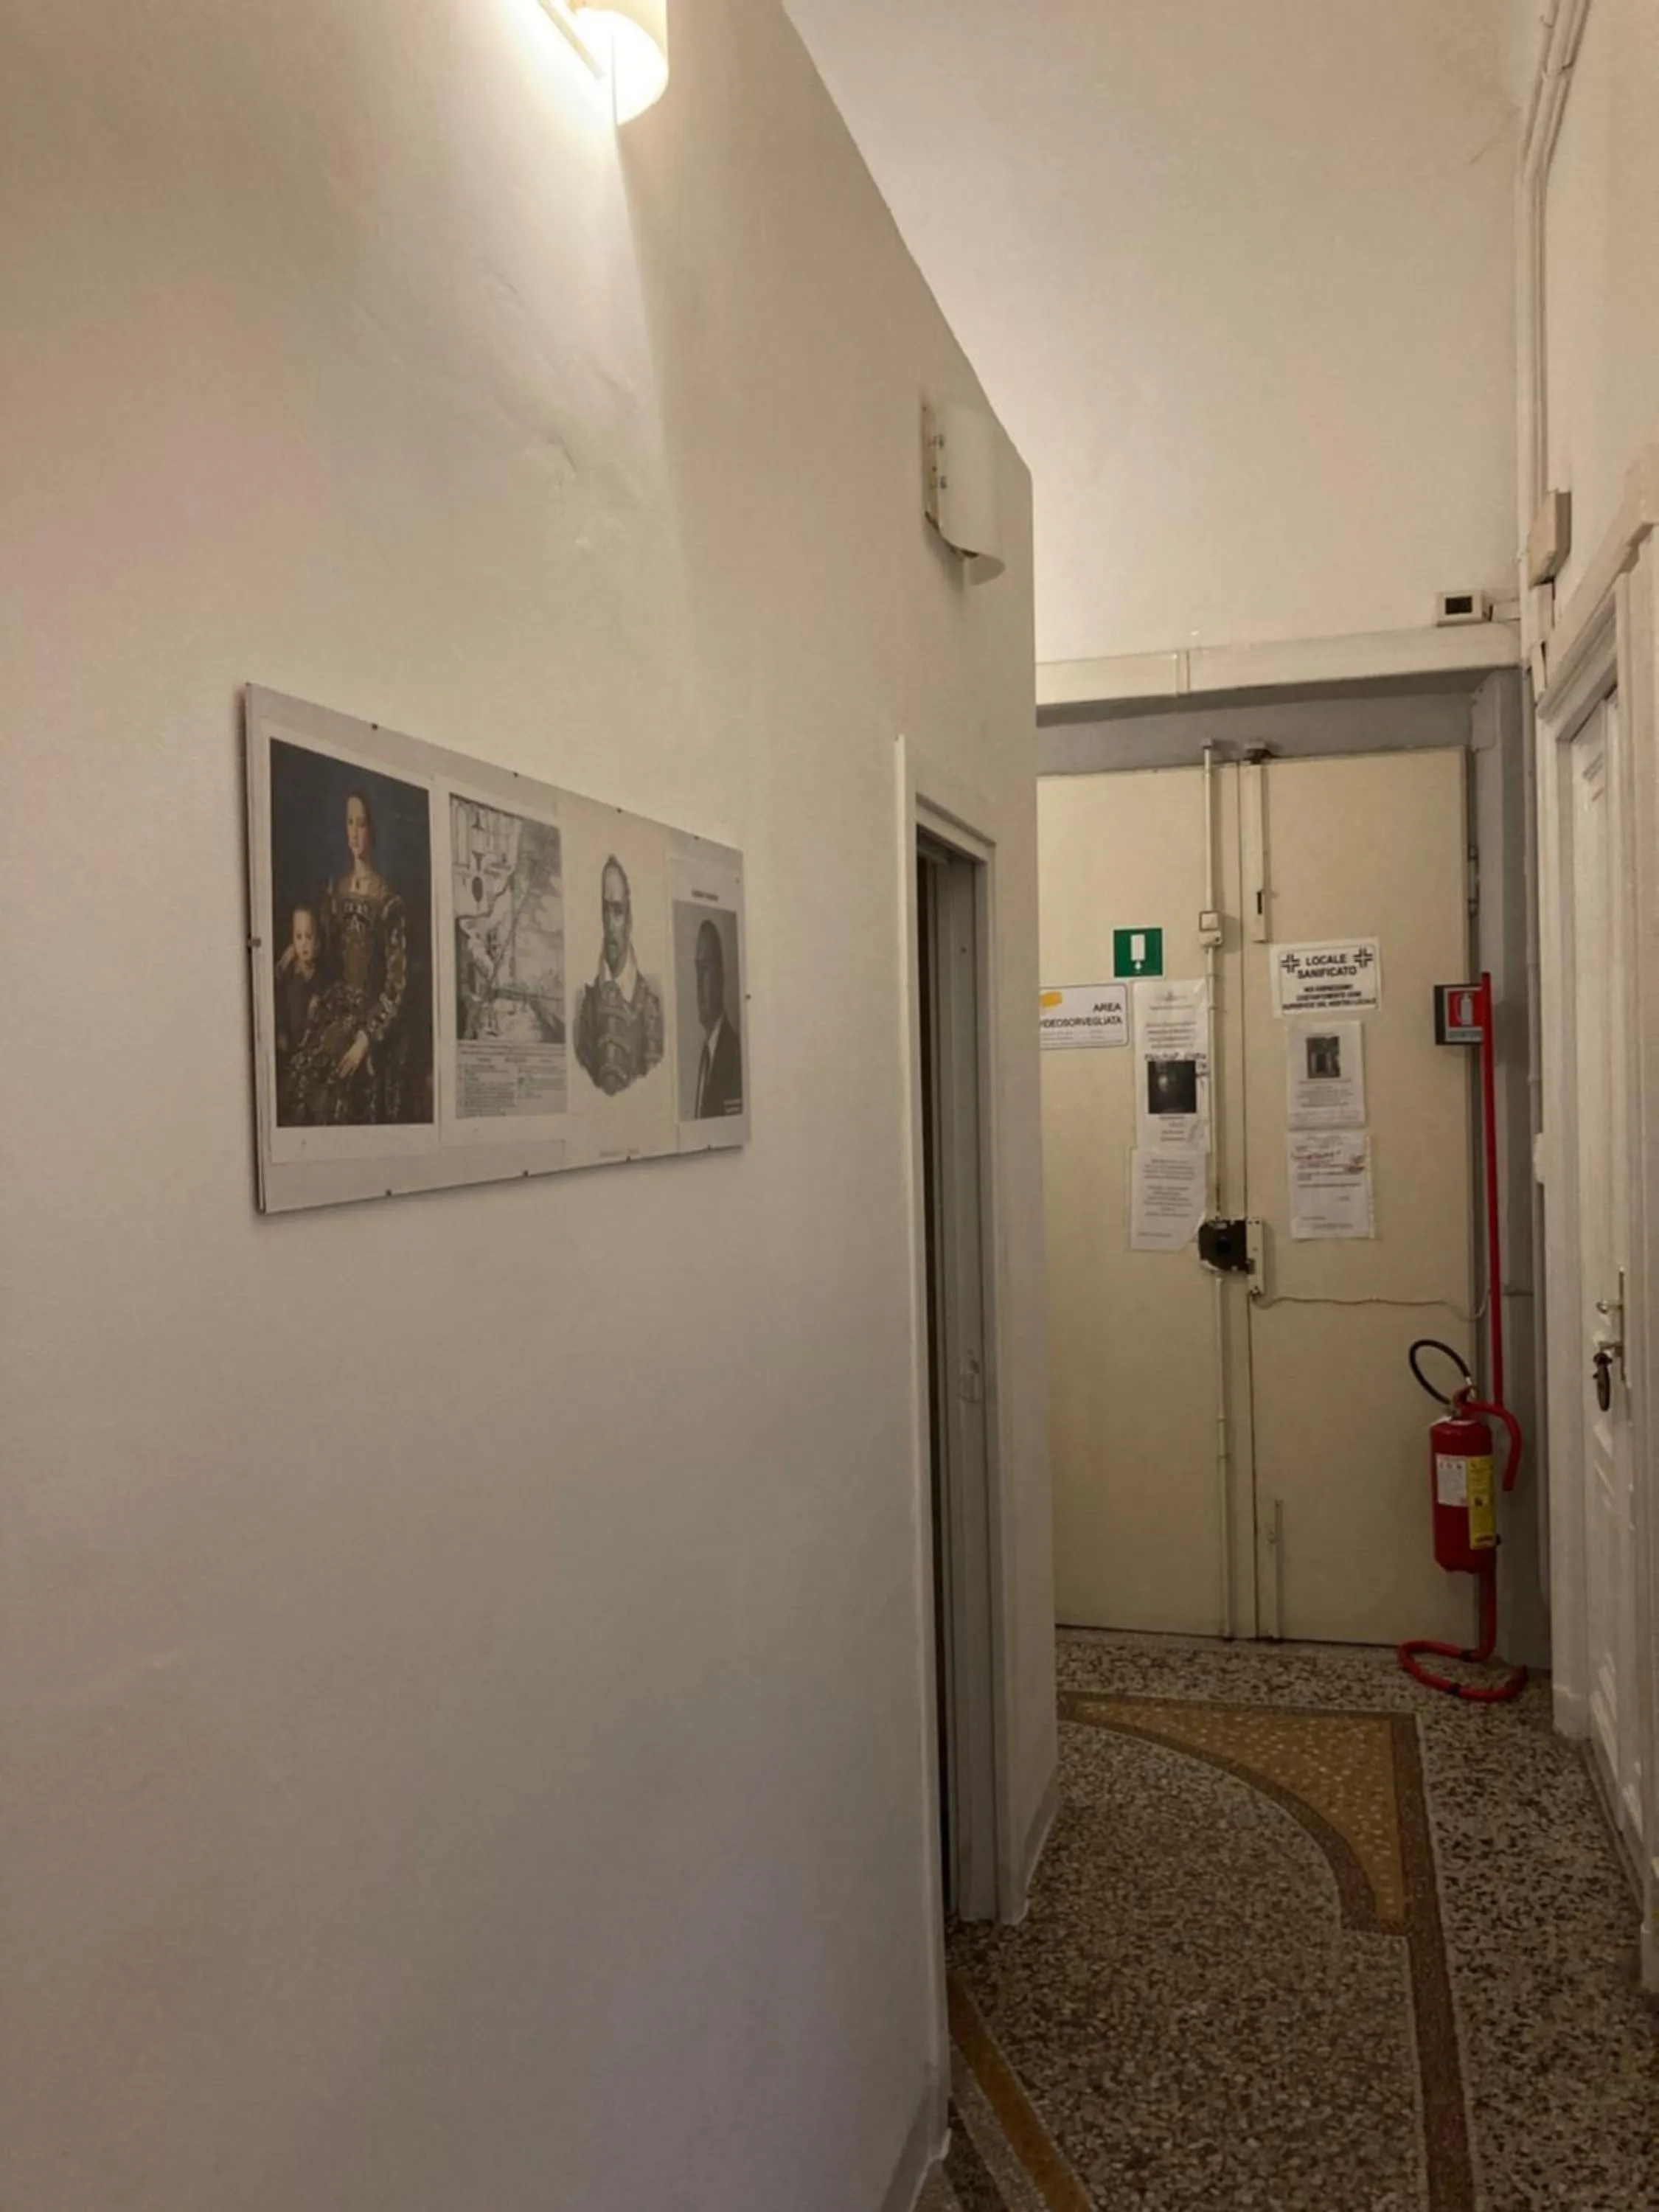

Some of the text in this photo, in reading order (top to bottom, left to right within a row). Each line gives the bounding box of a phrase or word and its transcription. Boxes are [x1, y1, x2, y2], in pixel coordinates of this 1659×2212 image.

[1306, 953, 1347, 967] LOCALE
[1298, 965, 1357, 979] SANIFICATO
[1093, 1002, 1121, 1012] AREA
